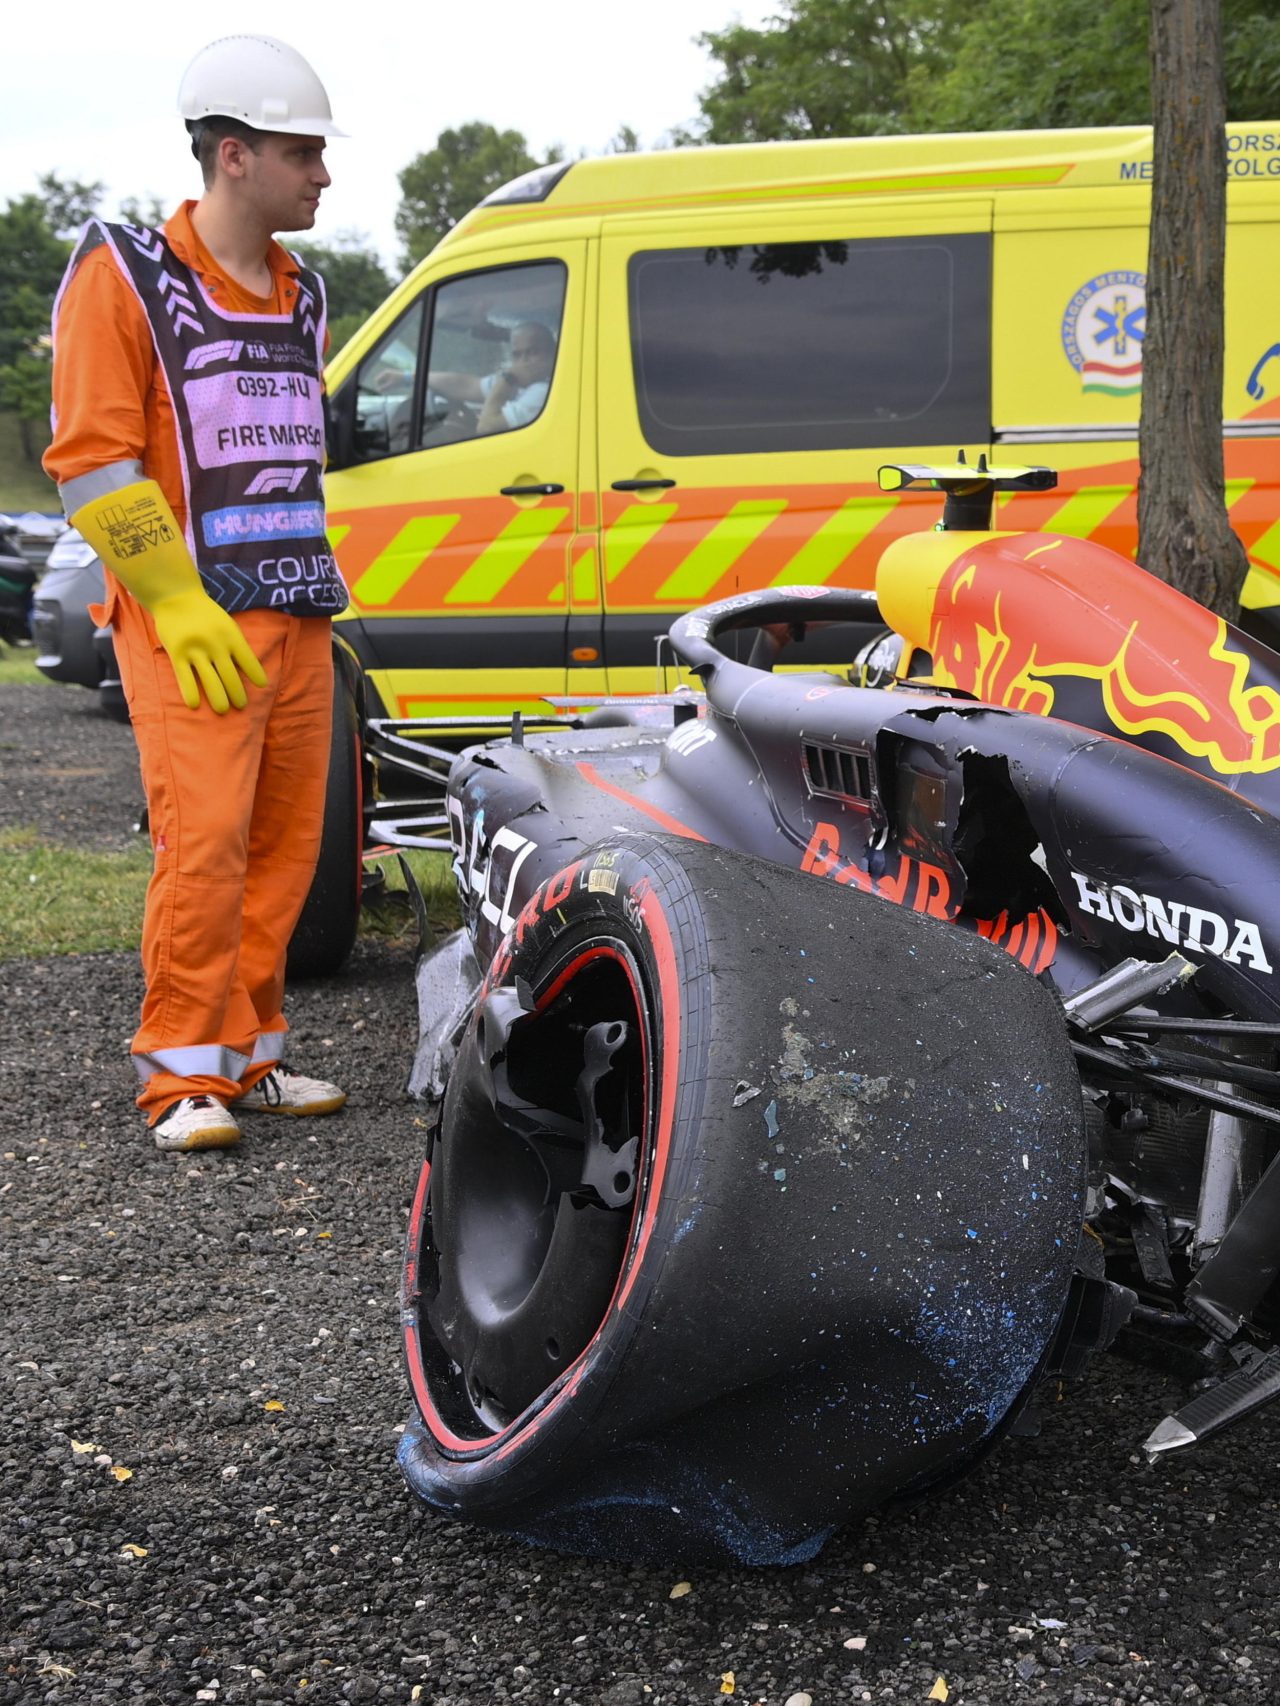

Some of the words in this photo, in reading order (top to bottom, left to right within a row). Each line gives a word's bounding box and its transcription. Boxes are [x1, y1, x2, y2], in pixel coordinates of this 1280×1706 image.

[246, 344, 269, 360] FIA
[218, 425, 267, 451] FIRE
[1070, 871, 1273, 975] HONDA
